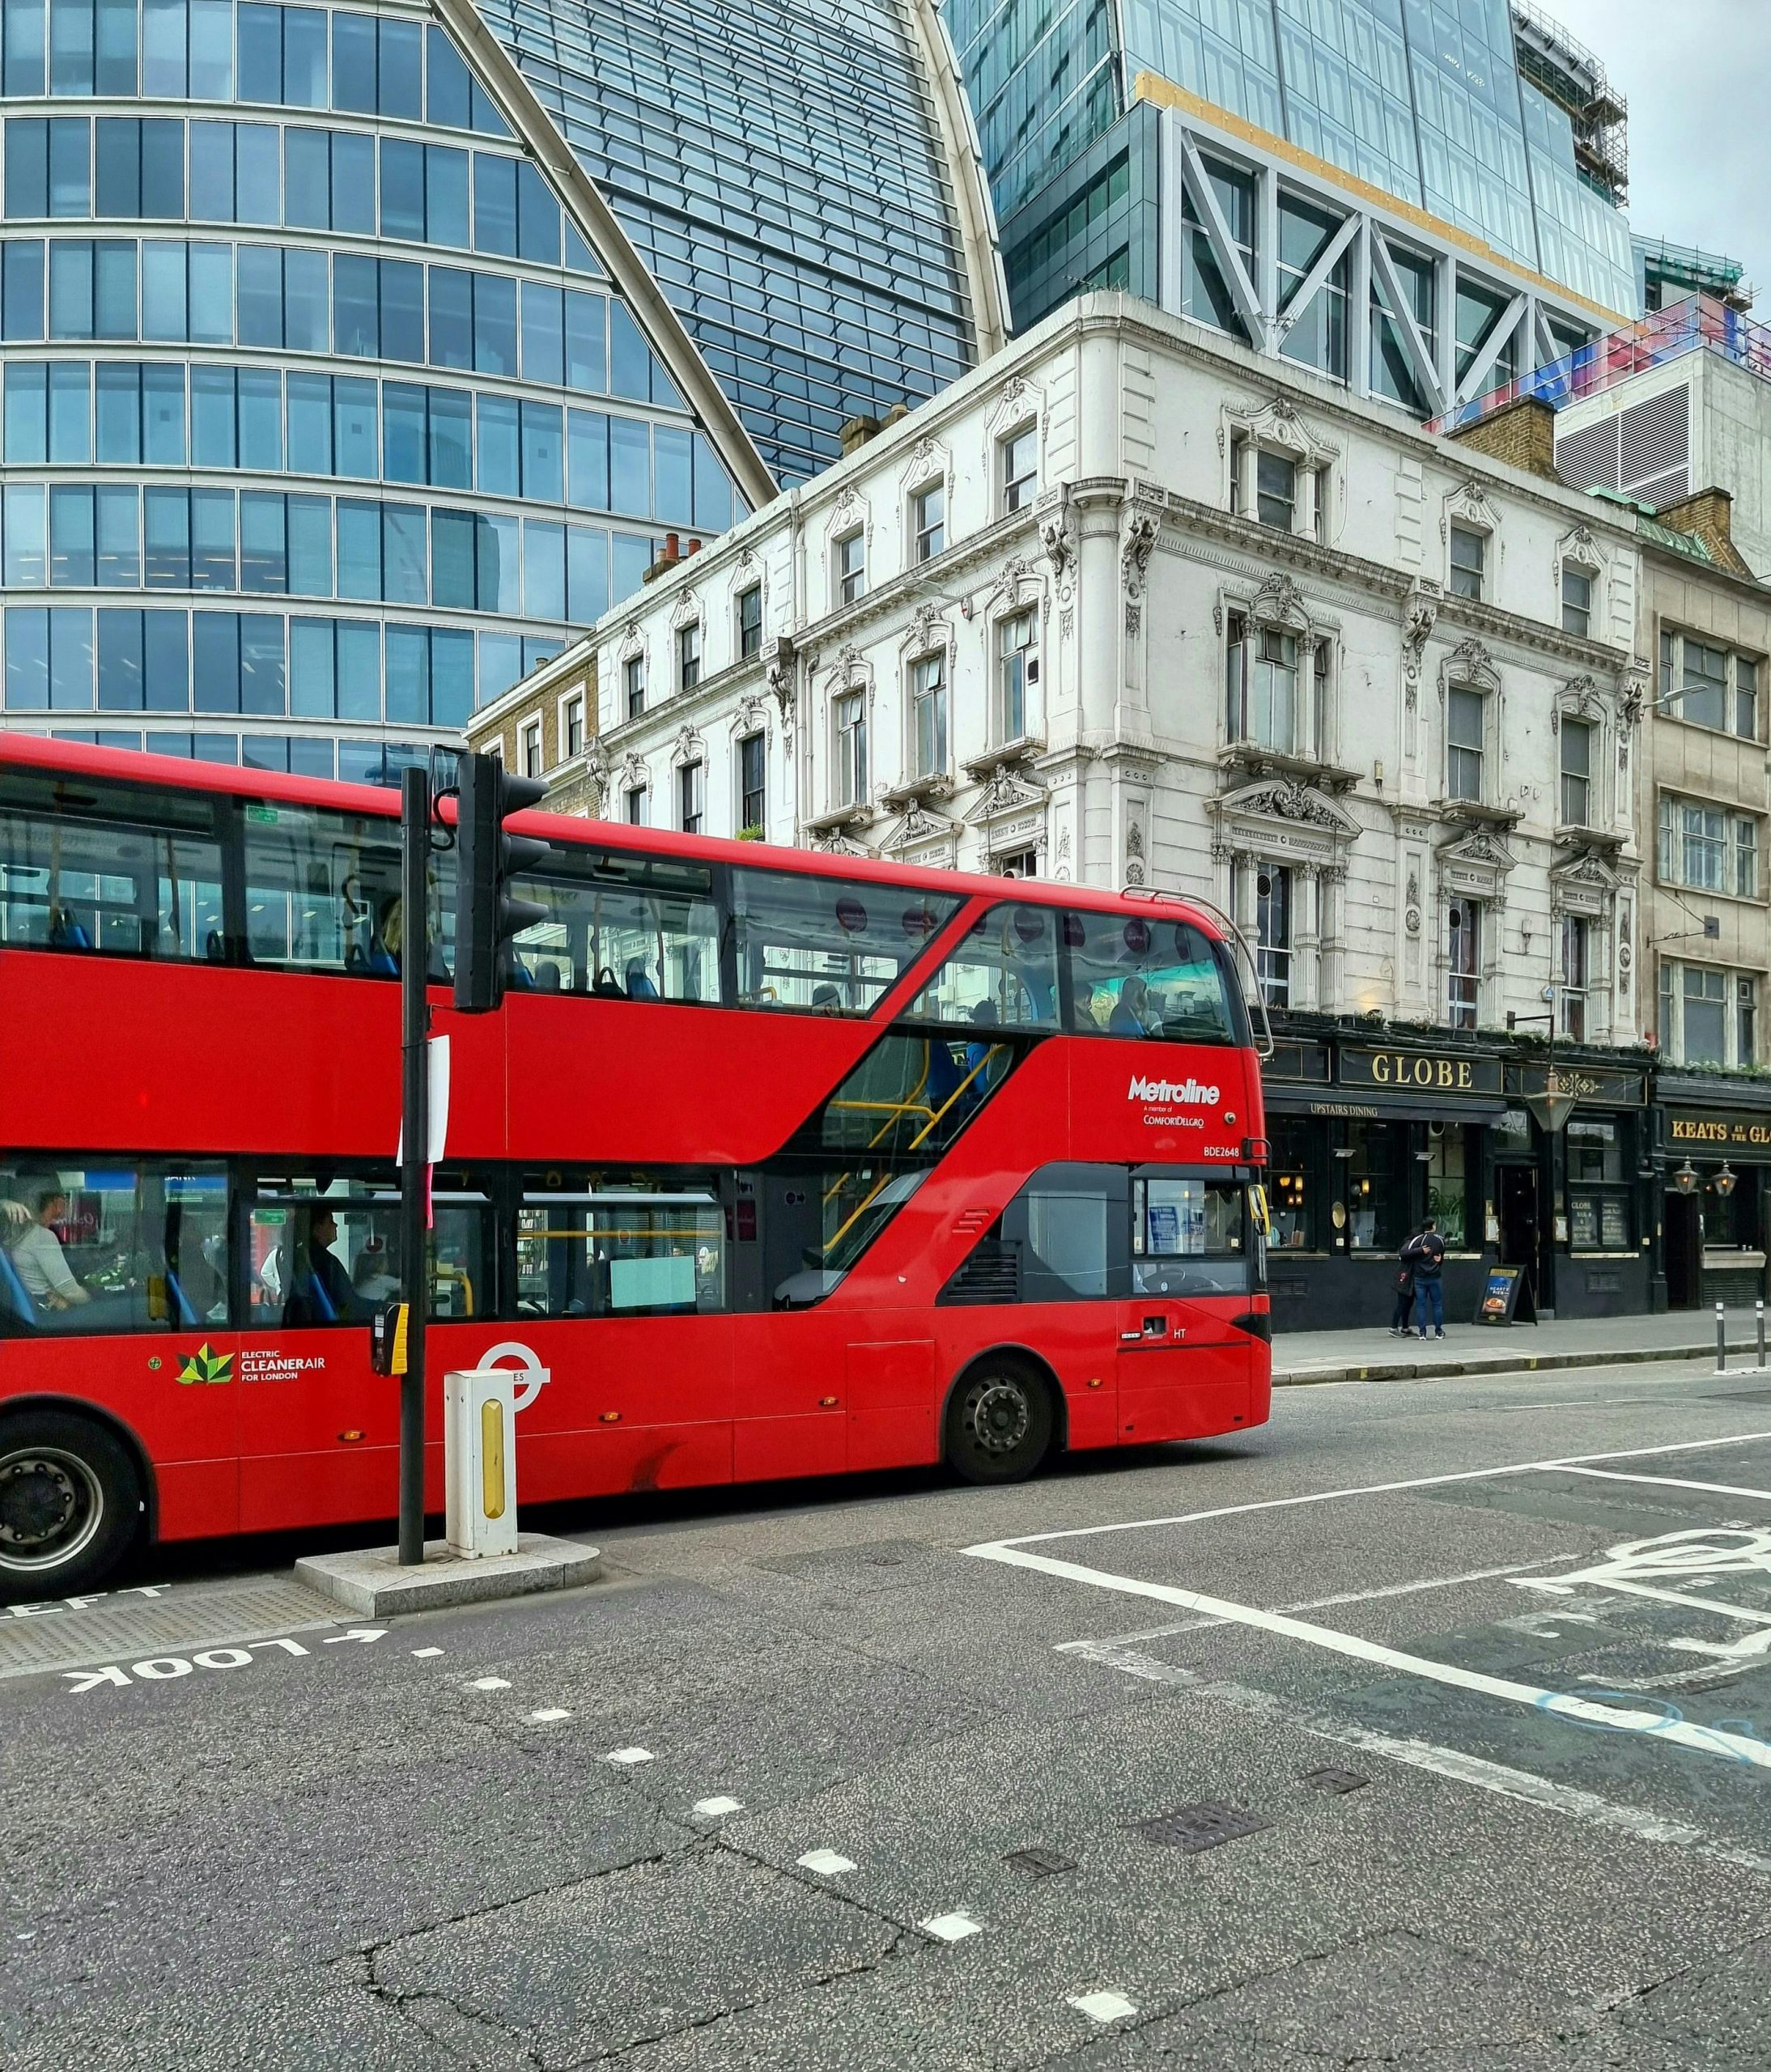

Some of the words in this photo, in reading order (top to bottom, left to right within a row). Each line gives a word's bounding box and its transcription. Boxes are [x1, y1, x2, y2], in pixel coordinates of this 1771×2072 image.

[1372, 1054, 1473, 1089] GLOBE
[1128, 1074, 1220, 1105] Metroline
[1310, 1103, 1348, 1115] UPSTAIRS
[1349, 1105, 1378, 1117] DINING
[1671, 1120, 1727, 1140] KEATS
[1749, 1126, 1771, 1143] GL
[1204, 1146, 1239, 1157] BDE2648
[1174, 1328, 1187, 1339] HT
[241, 1350, 280, 1359] ELECTRIC
[241, 1374, 259, 1382] FOR
[261, 1372, 298, 1381] LONDON
[513, 1373, 525, 1382] ES
[0, 1584, 172, 1620] EFT
[61, 1638, 312, 1694] LOOK
